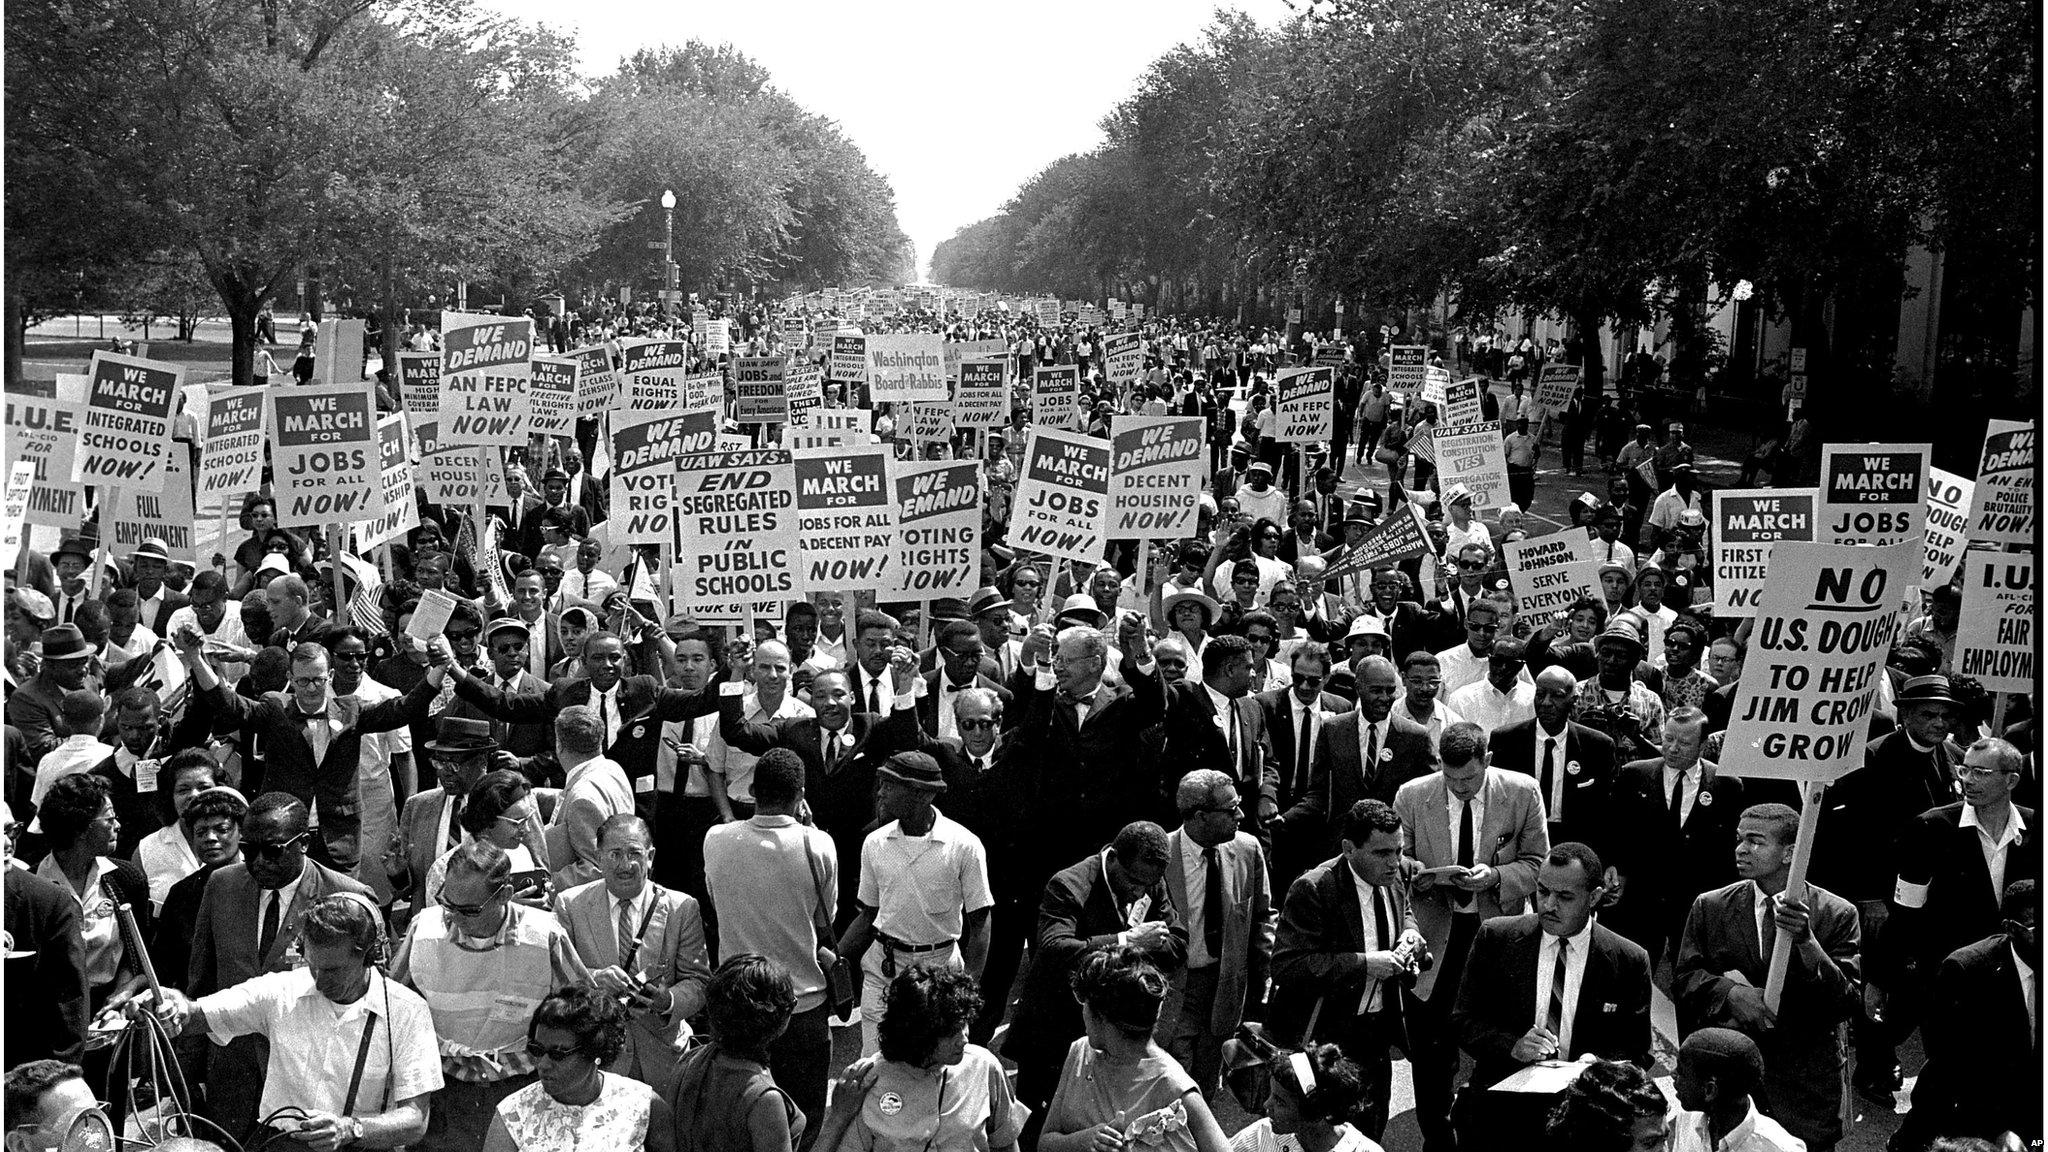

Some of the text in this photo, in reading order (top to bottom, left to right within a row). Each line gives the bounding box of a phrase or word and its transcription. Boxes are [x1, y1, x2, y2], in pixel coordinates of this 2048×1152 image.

[472, 325, 504, 346] WE
[448, 339, 526, 370] DEMAND
[644, 344, 665, 357] WE
[1108, 353, 1140, 364] AN FEPC
[1395, 354, 1423, 362] MARCH
[541, 363, 557, 373] WE
[628, 354, 682, 371] DEMAND
[872, 351, 939, 370] Washington
[123, 367, 147, 382] WE
[590, 374, 613, 385] CLASS
[738, 370, 782, 382] JOBS and
[834, 370, 863, 379] NOW!
[964, 373, 1000, 382] MARCH
[1112, 367, 1140, 378] NOW!
[1295, 371, 1316, 386] WE
[448, 376, 527, 394] AN FEPC
[634, 376, 676, 387] EQUAL
[875, 373, 943, 390] Board Rabbis
[1039, 378, 1072, 388] MARCH
[1282, 379, 1330, 400] DEMAND
[1391, 381, 1421, 389] NOW!
[1555, 385, 1572, 393] END
[98, 379, 166, 405] MARCH
[632, 387, 677, 399] RIGHTS
[738, 385, 783, 396] FREEDOM
[959, 391, 976, 399] JOBS
[977, 391, 990, 399] FOR
[1449, 388, 1475, 399] MARCH
[115, 400, 142, 413] FOR
[226, 398, 243, 410] WE
[308, 398, 337, 412] WE
[466, 396, 512, 412] LAW
[541, 401, 574, 410] RIGHTS
[577, 393, 614, 412] NOW!
[965, 401, 988, 409] DECENT
[1039, 396, 1072, 407] JOBS
[1281, 401, 1330, 413] AN FEPC
[211, 405, 257, 428] MARCH
[532, 407, 557, 416] LAWS
[925, 408, 950, 417] FEPC
[961, 410, 999, 423] NOW!
[1038, 412, 1073, 426] NOW!
[1292, 414, 1320, 424] LAW
[86, 411, 165, 436] INTEGRATED
[284, 411, 363, 432] MARCH
[452, 414, 522, 436] NOW!
[1452, 414, 1478, 426] NOW!
[223, 424, 242, 434] FOR
[310, 432, 342, 442] FOR
[646, 418, 684, 442] WE
[1142, 425, 1174, 445] WE
[1284, 422, 1327, 438] NOW!
[1436, 422, 1497, 437] UAW SAYS:
[25, 441, 52, 453] FOR
[82, 432, 161, 457] SCHOOLS
[205, 433, 260, 454] INTEGRATED
[620, 431, 712, 470] DEMAND
[203, 450, 258, 471] SCHOOLS
[681, 450, 786, 470] UAW SAYS:
[1064, 445, 1088, 460] WE
[1118, 440, 1199, 470] DEMAND
[83, 455, 155, 480] NOW!
[288, 449, 366, 475] JOBS
[824, 459, 853, 475] WE
[1036, 454, 1108, 483] MARCH
[1458, 455, 1481, 472] YES
[1864, 457, 1891, 472] WE
[204, 466, 254, 492] NOW!
[292, 474, 366, 490] FOR ALL
[697, 470, 772, 493] END
[802, 475, 880, 497] MARCH
[912, 471, 949, 496] WE
[1056, 475, 1084, 488] FOR
[1125, 475, 1191, 489] DECENT
[1835, 473, 1915, 491] MARCH
[1987, 475, 2012, 488] AN
[292, 487, 372, 517] NOW!
[683, 489, 792, 516] SEGREGATED
[827, 496, 857, 506] FOR
[1029, 490, 1100, 518] JOBS
[1116, 494, 1195, 508] HOUSING
[1858, 492, 1890, 502] FOR
[1996, 491, 2029, 504] POLICE
[136, 495, 161, 519] FULL
[1753, 500, 1780, 512] WE
[1984, 502, 2033, 515] BRUTALITY
[364, 502, 409, 543] NOW!
[699, 511, 777, 535] RULES
[834, 513, 891, 529] FOR ALL
[1028, 509, 1093, 531] FOR ALL
[1118, 509, 1190, 530] NOW!
[1388, 514, 1412, 533] WE WANT
[1727, 513, 1806, 531] MARCH
[1832, 512, 1911, 533] JOBS
[811, 534, 892, 550] DECENT PAY
[1019, 525, 1096, 554] NOW!
[1383, 530, 1419, 552] FOR JOBS
[1751, 531, 1782, 540] FOR
[724, 538, 753, 551] IN
[1396, 539, 1424, 555] MARCH
[1518, 541, 1565, 559] HOWARD
[698, 550, 787, 574] PUBLIC
[1721, 549, 1763, 562] FIRST
[810, 553, 890, 582] NOW!
[695, 571, 793, 597] SCHOOLS
[1532, 571, 1569, 589] SERVE
[1815, 566, 1888, 605] NO
[1759, 610, 1897, 655] U.S. DOUGH
[1997, 617, 2031, 646] FAIR
[1769, 661, 1878, 694] TO HELP
[1741, 688, 1877, 726] JIM CROW
[1762, 730, 1856, 761] GROW
